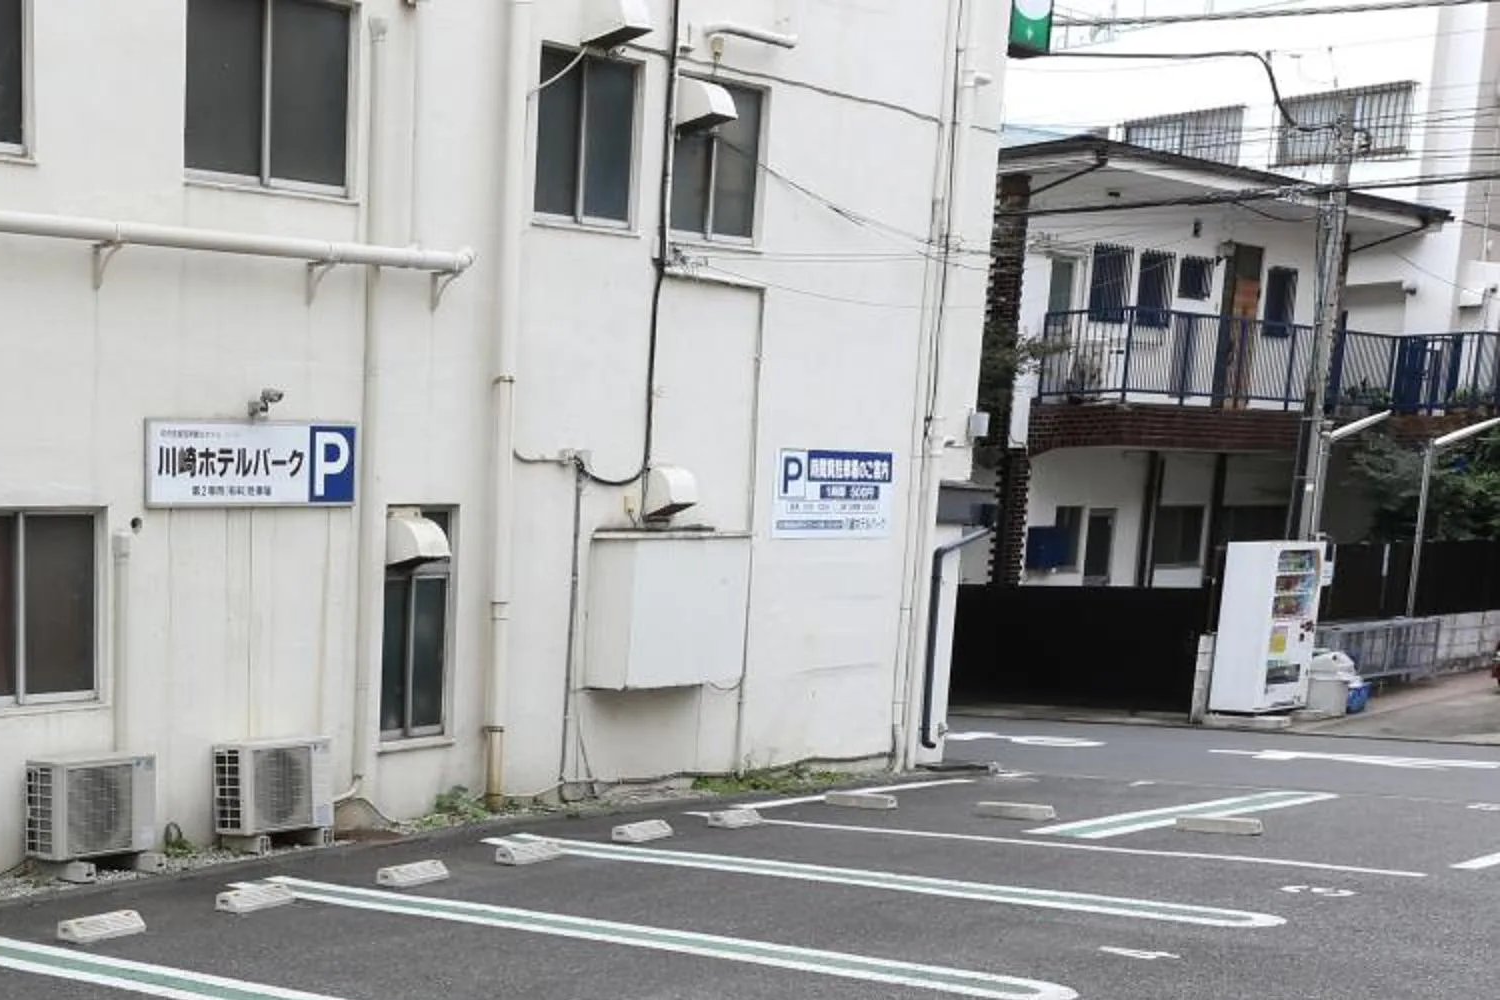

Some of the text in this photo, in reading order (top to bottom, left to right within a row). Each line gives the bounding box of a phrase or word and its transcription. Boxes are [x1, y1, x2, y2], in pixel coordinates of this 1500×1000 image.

[157, 445, 304, 478] 川崎ホテルパーク
[314, 432, 350, 497] P
[782, 456, 803, 494] P
